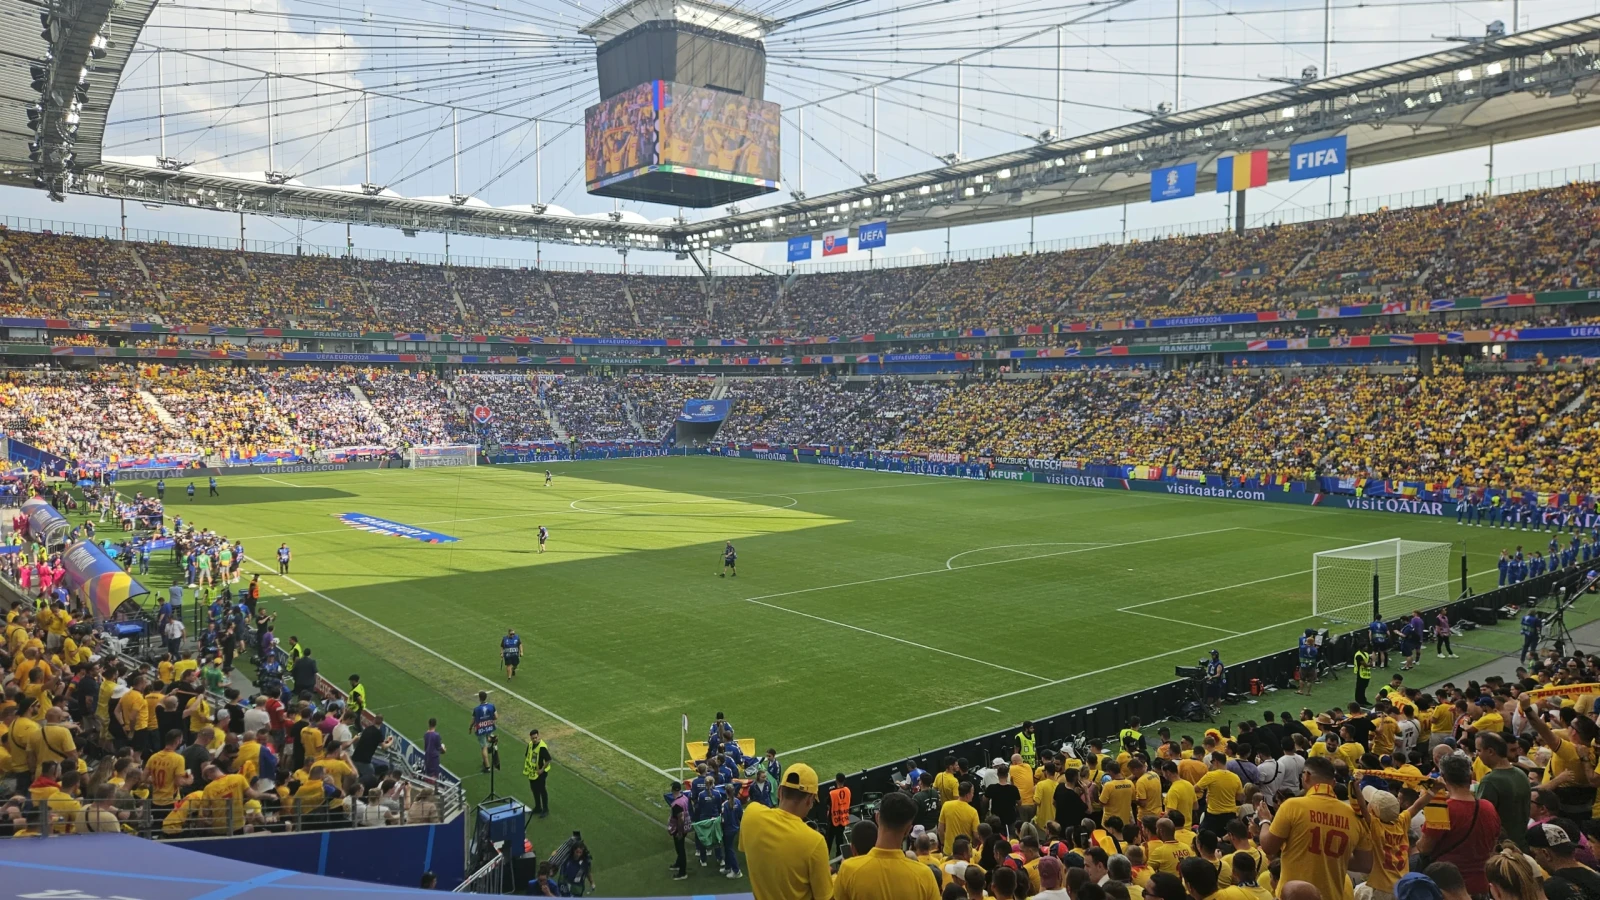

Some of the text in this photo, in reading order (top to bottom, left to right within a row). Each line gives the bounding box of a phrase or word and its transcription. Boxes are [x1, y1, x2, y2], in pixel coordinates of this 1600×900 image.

[1297, 148, 1338, 170] FIFA
[704, 170, 748, 183] FRANKFURT
[860, 229, 884, 242] UEFA
[1159, 344, 1212, 352] FRANKFURT
[995, 456, 1027, 465] HARZBURG
[1028, 459, 1061, 471] KETSCH
[260, 463, 345, 474] visitqatar.com
[1166, 482, 1265, 500] visitqatar.com
[1309, 809, 1350, 830] ROMANIA
[1308, 826, 1349, 859] 10
